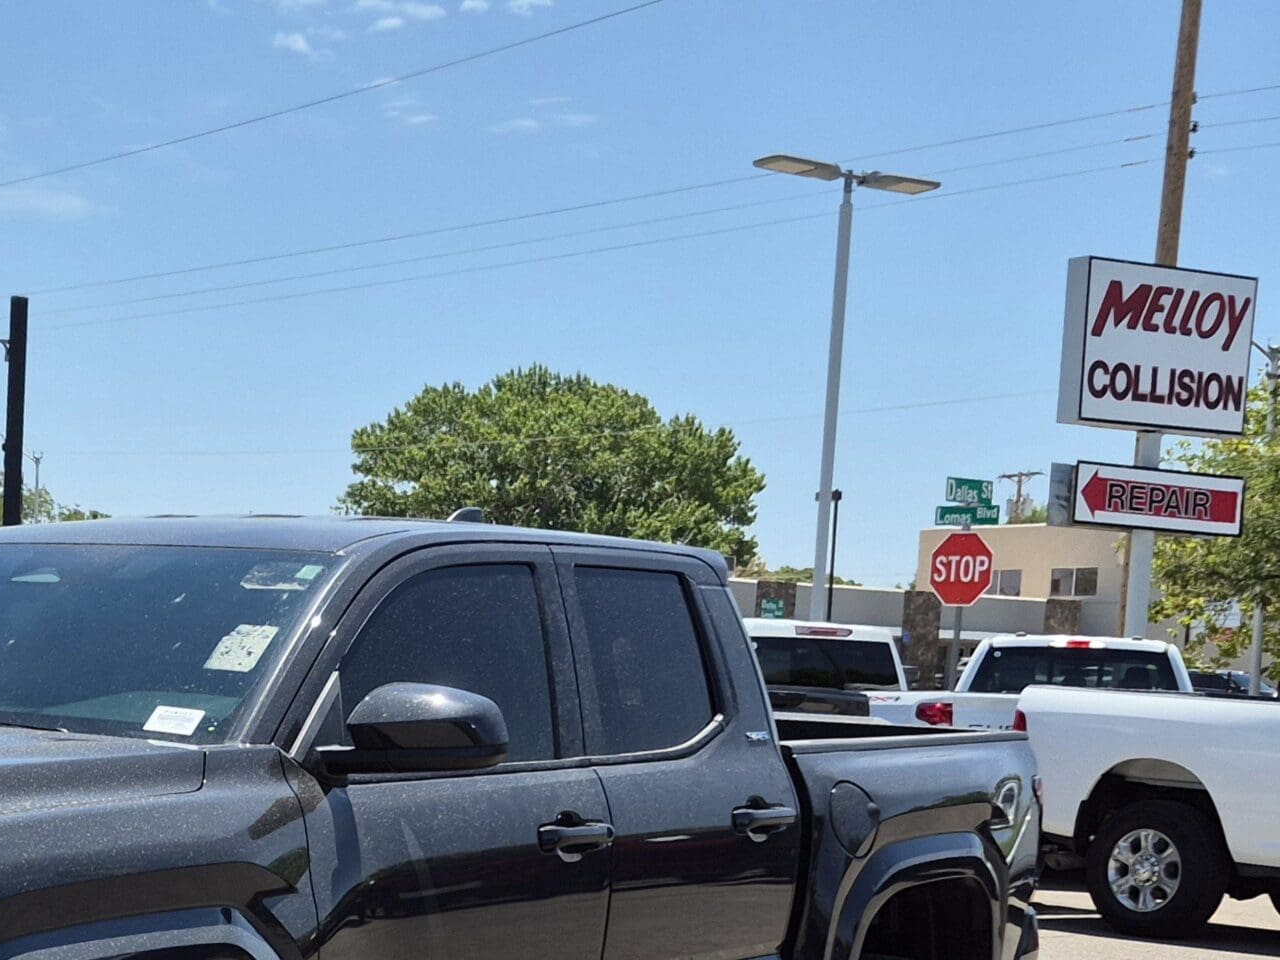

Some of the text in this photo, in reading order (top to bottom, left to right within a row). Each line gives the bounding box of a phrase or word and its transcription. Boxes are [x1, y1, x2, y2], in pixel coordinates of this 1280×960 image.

[1091, 280, 1251, 351] MELLOY
[1087, 360, 1244, 412] COLLISION
[947, 479, 992, 502] Dallas St
[1106, 481, 1212, 519] REPAIR
[936, 507, 998, 525] Lomas Blvd
[933, 555, 990, 583] STOP
